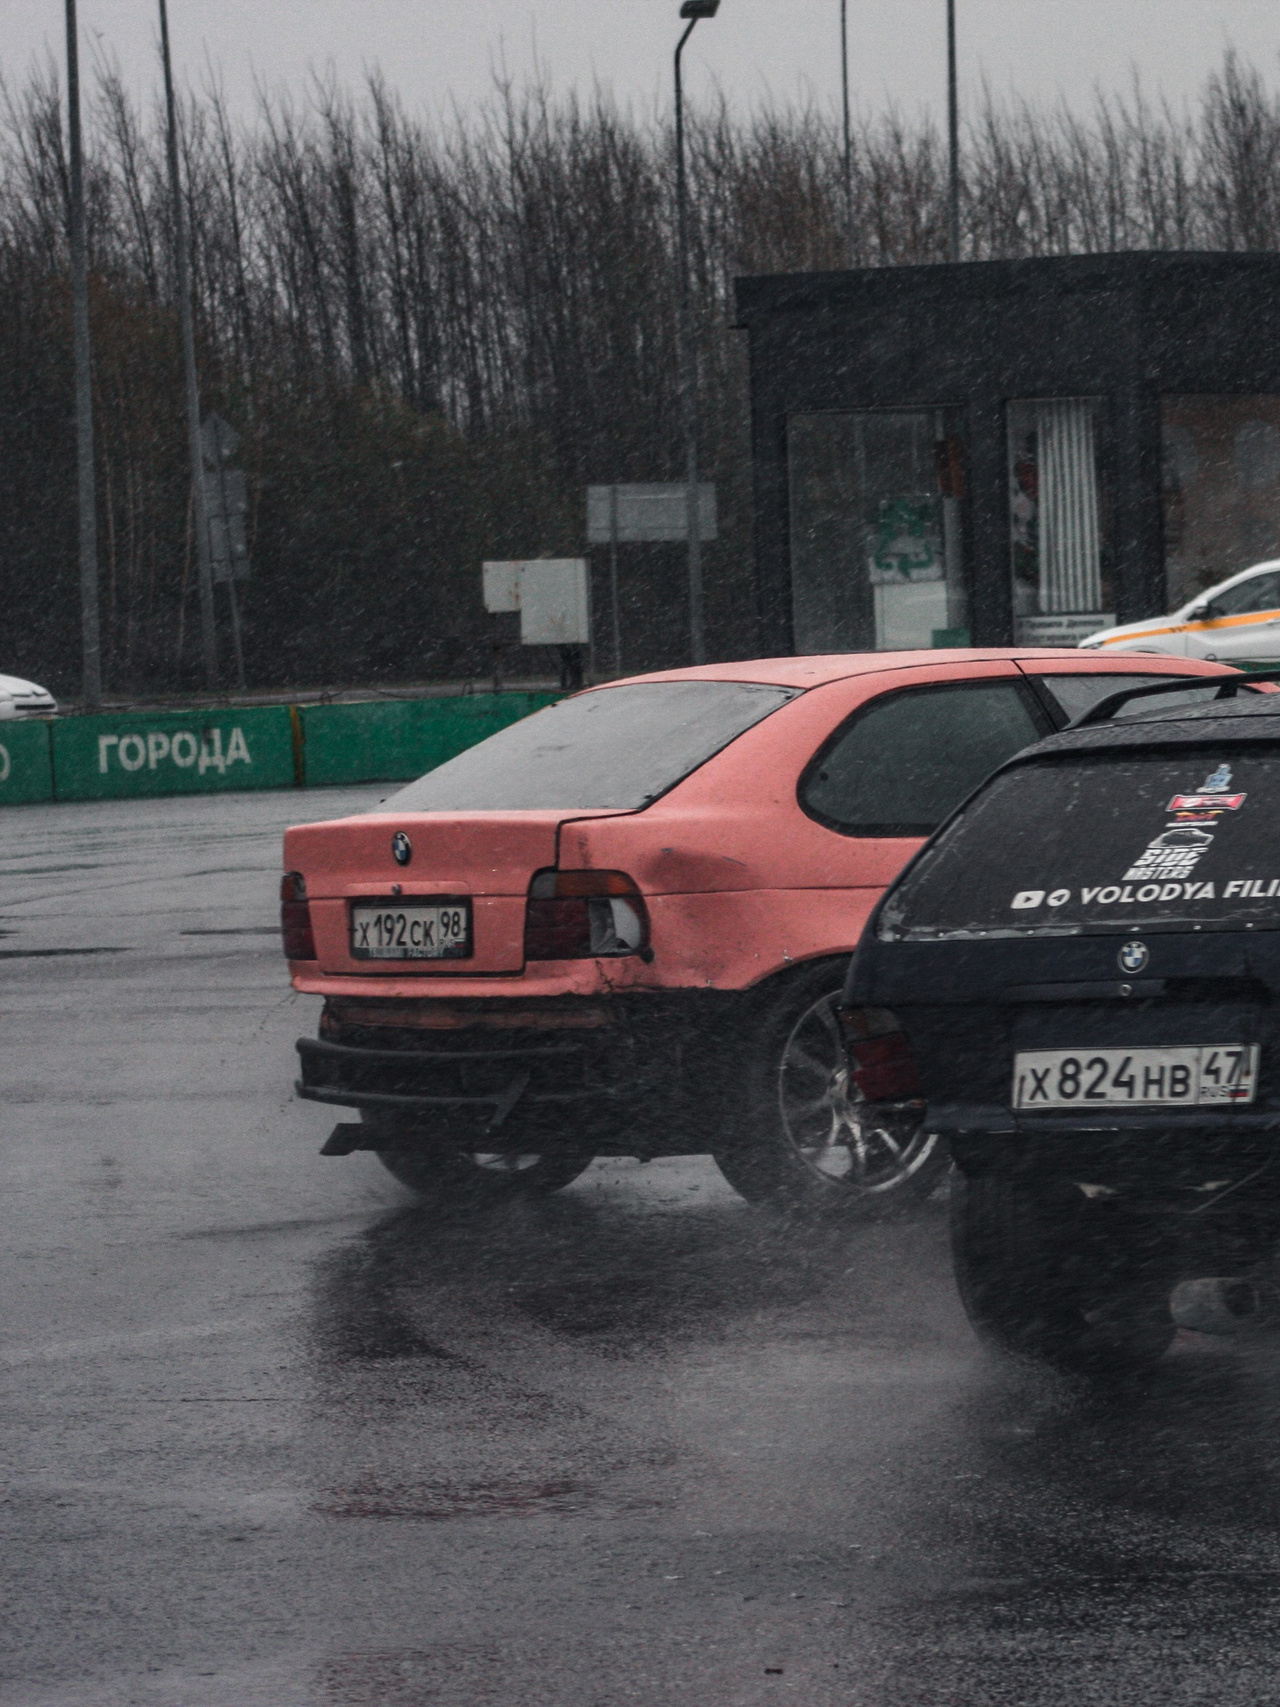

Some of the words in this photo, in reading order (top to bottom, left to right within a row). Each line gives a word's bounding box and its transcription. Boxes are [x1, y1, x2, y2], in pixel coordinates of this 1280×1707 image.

[98, 727, 251, 775] ГОРОДА
[1080, 881, 1216, 905] VOLODYA
[440, 911, 461, 938] 98
[1203, 1050, 1244, 1085] 47
